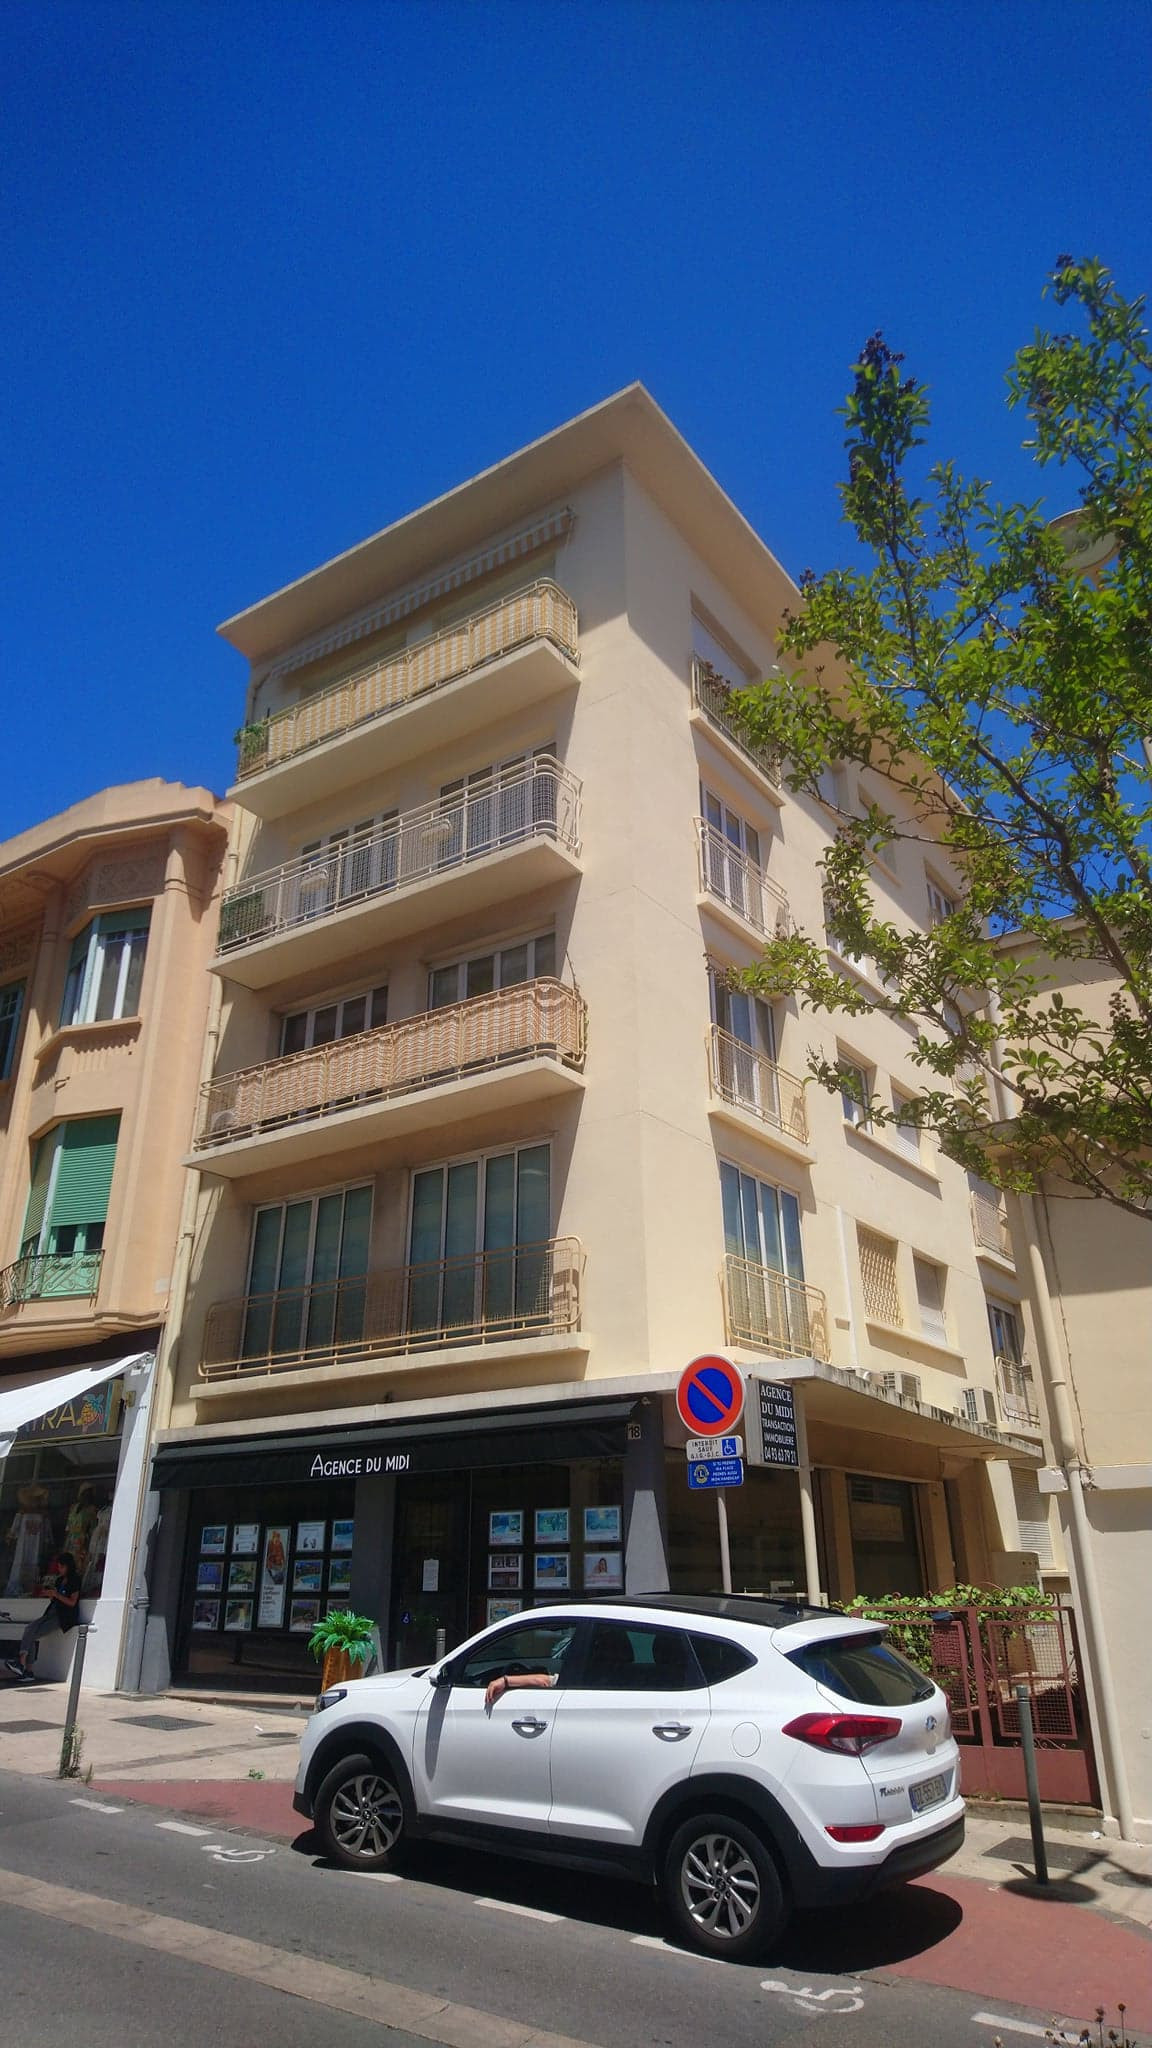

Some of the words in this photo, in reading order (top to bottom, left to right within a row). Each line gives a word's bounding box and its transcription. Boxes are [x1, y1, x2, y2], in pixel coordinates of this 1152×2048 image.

[760, 1384, 792, 1402] AGENCE
[761, 1402, 774, 1415] DU
[775, 1403, 793, 1419] MIDI
[628, 1425, 640, 1438] 18
[761, 1418, 795, 1433] TRANSACTION
[310, 1454, 362, 1477] AGENCE
[366, 1457, 381, 1473] DU
[385, 1454, 410, 1471] MIDI
